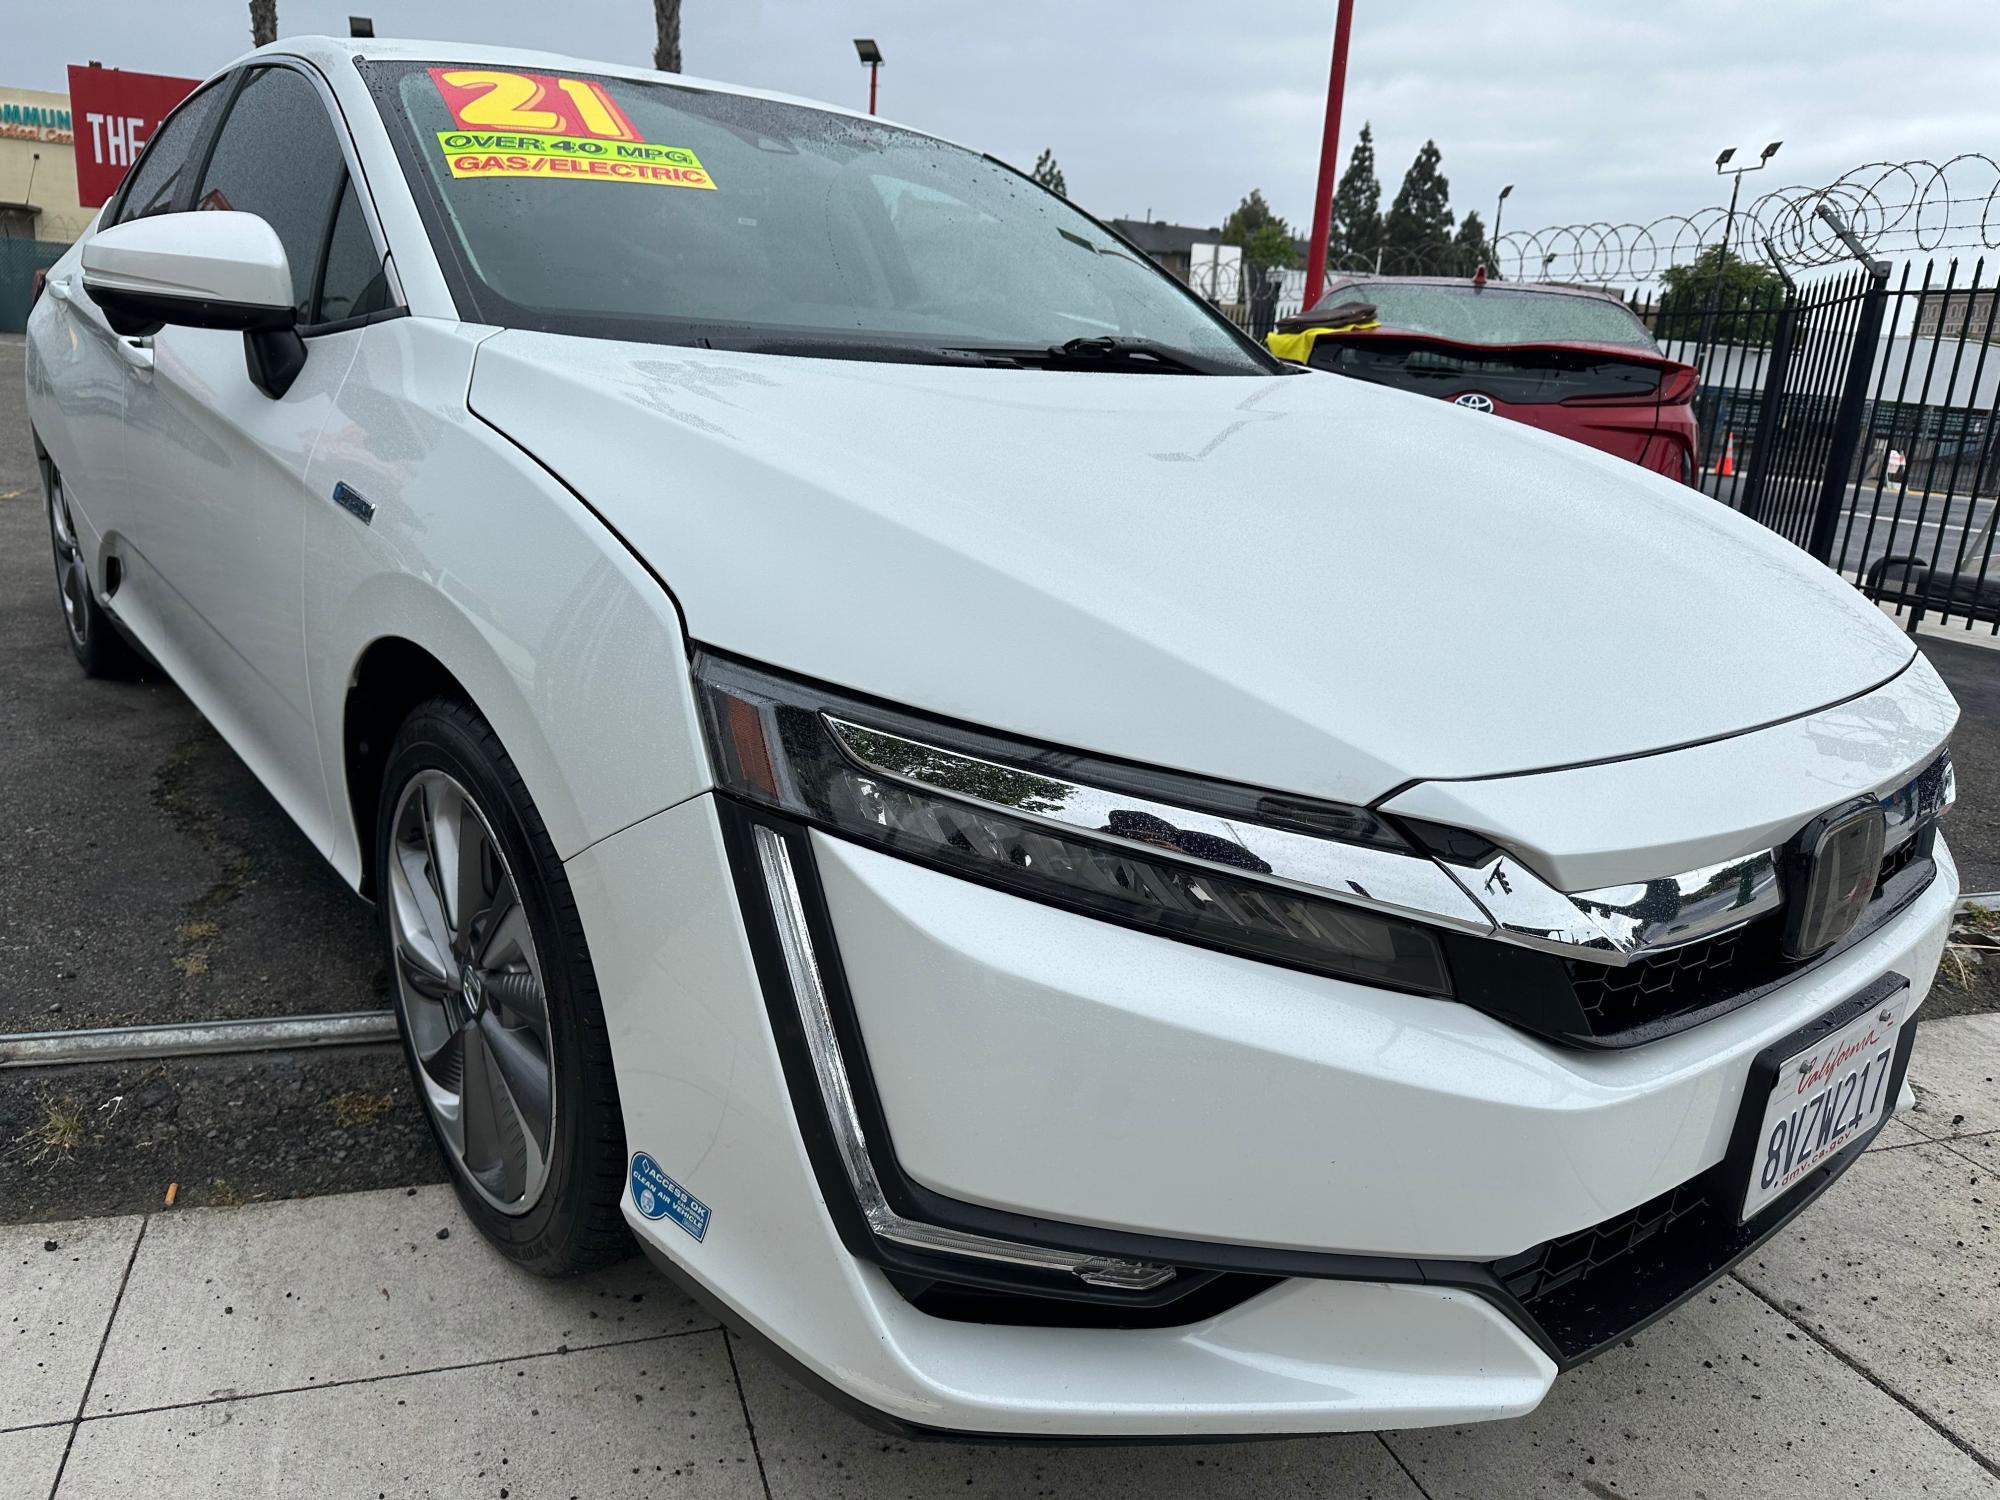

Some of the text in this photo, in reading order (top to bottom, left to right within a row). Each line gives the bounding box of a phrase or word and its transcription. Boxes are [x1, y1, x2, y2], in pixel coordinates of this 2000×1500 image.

[0, 104, 71, 131] MMUN
[441, 70, 634, 139] 21
[86, 112, 146, 166] THE
[444, 134, 693, 165] OVER 40 MPG
[453, 155, 708, 184] GAS/ELECTRIC
[1797, 1025, 1880, 1095] California
[1761, 1047, 1891, 1190] 8VZW217
[1781, 1131, 1851, 1187] dmv.ca.gov
[633, 1170, 657, 1193] CLEAN
[657, 1191, 671, 1204] AIR
[672, 1201, 704, 1230] VEHICLE
[648, 1169, 707, 1218] ACCESS OK
